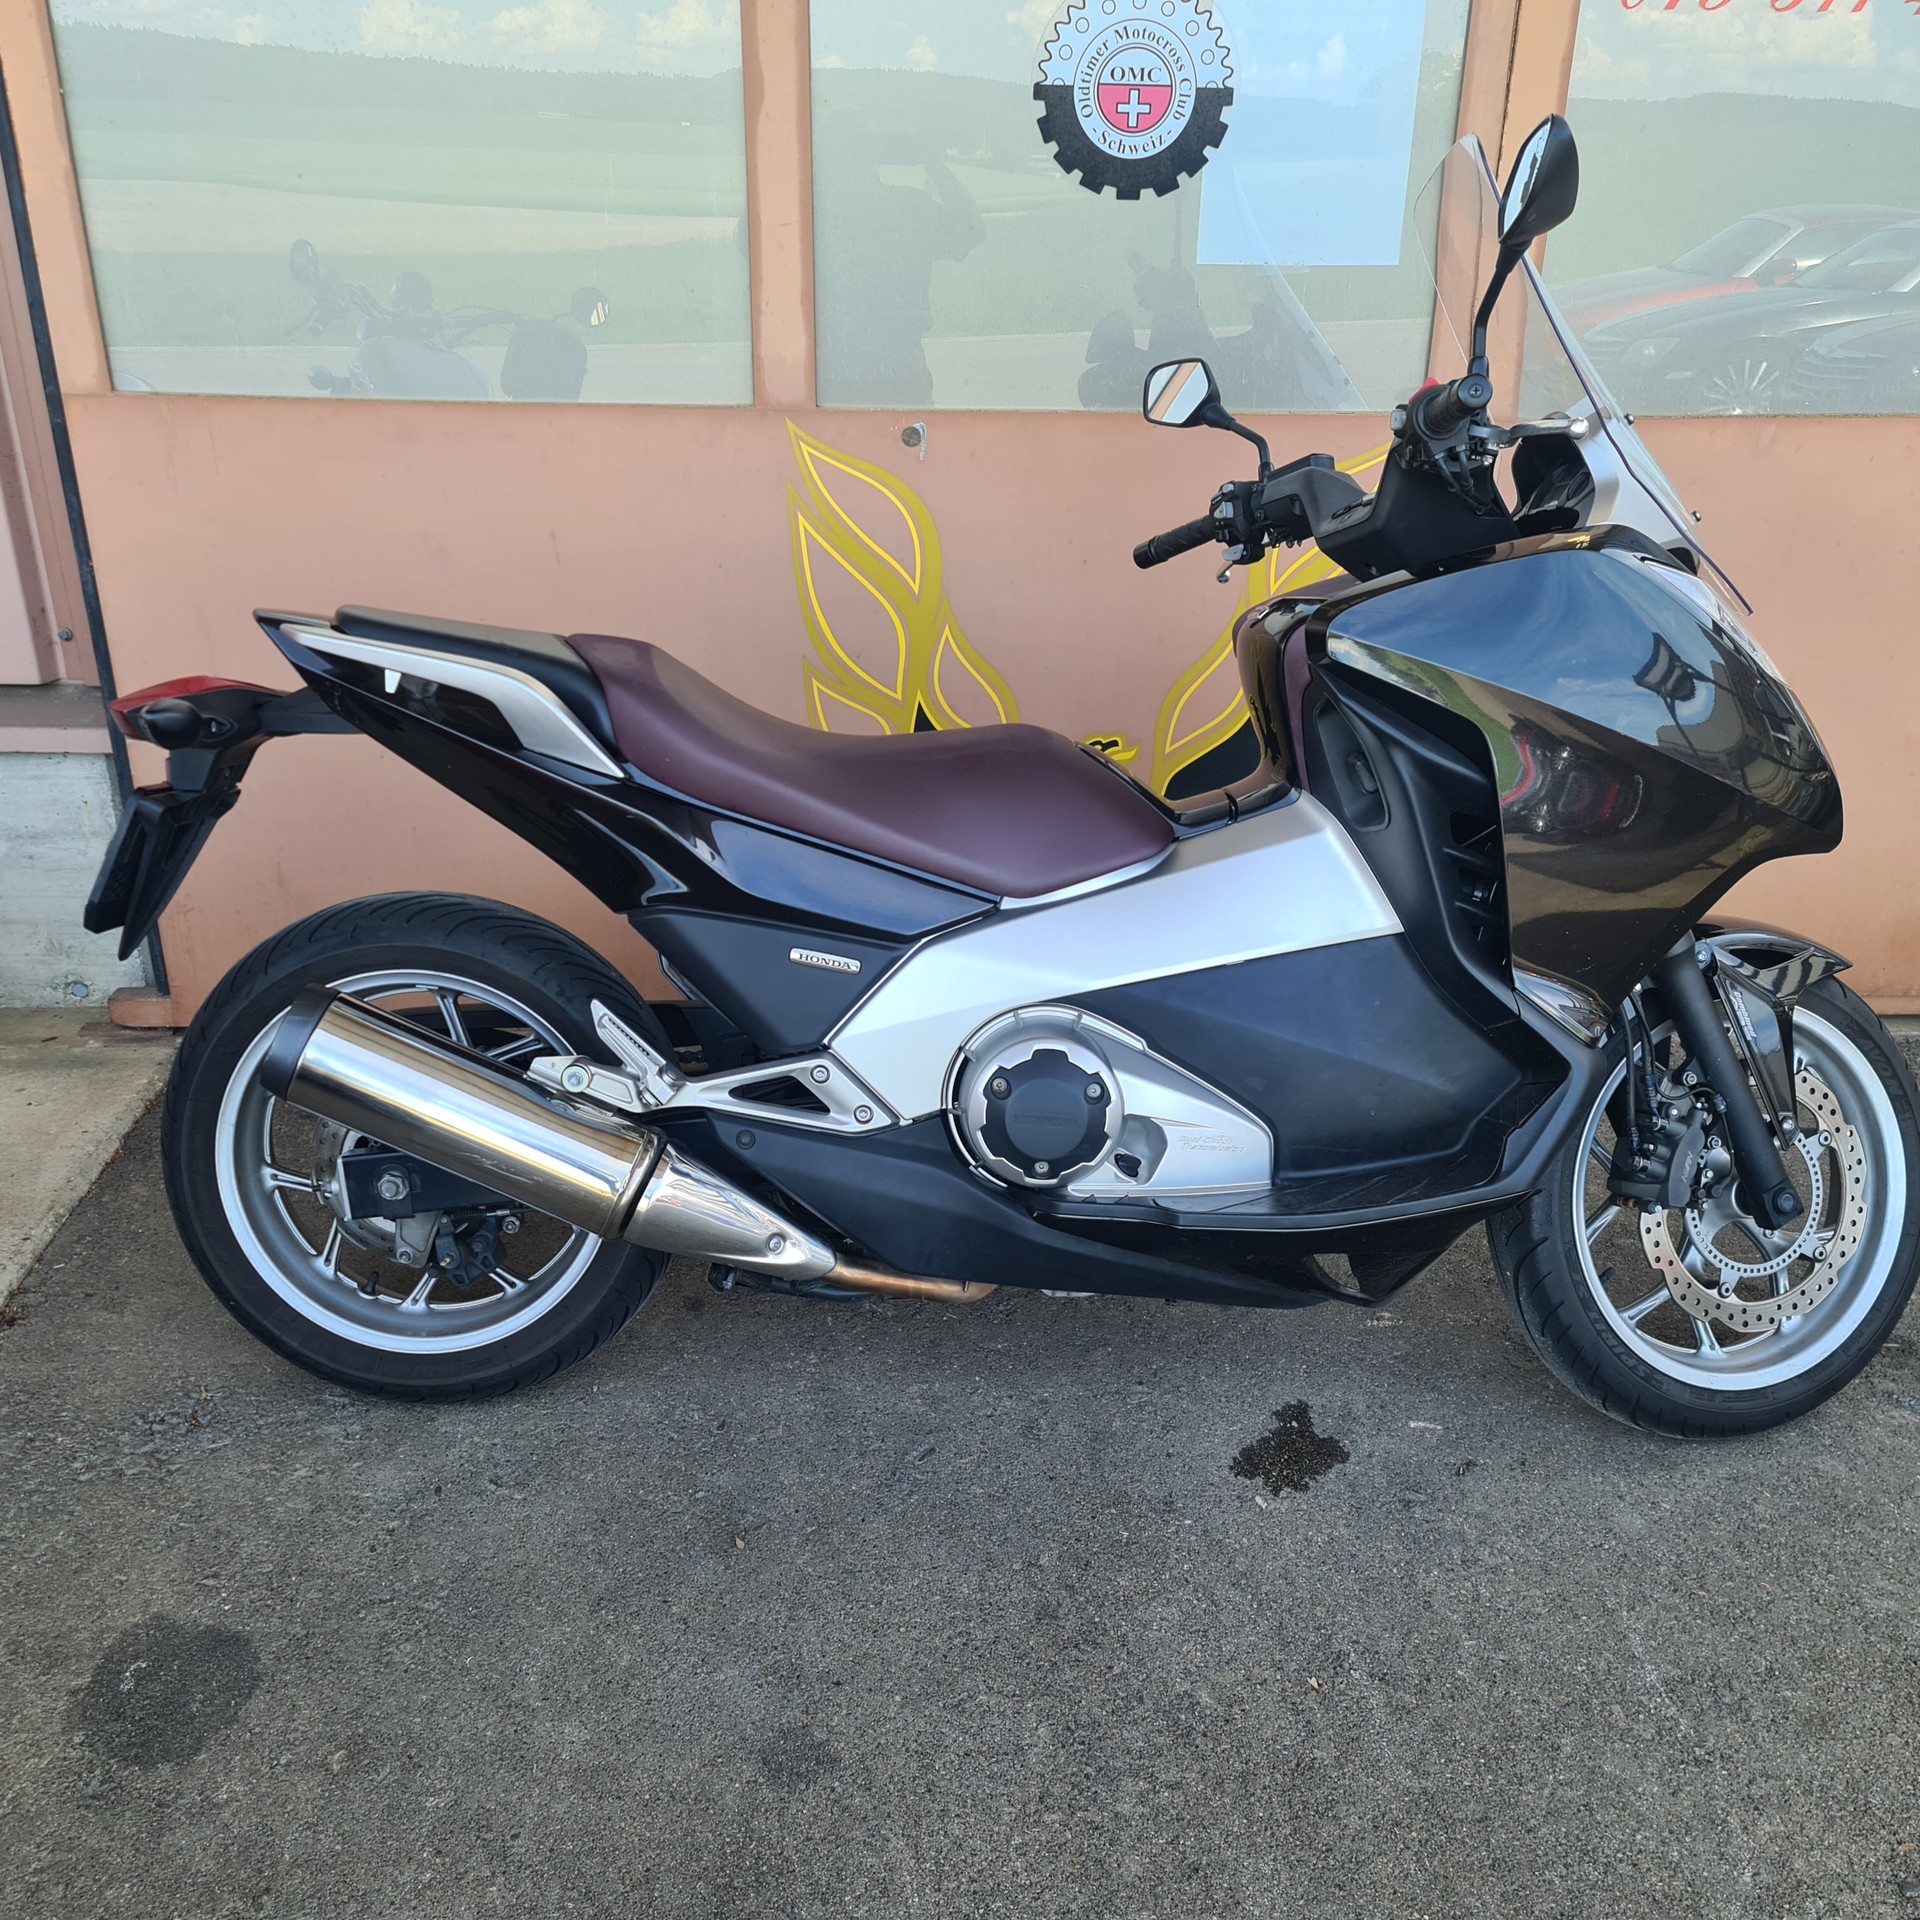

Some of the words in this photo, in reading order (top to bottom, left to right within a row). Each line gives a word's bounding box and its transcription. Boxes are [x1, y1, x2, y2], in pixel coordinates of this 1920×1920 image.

[1079, 39, 1109, 118] Oldtimer
[1114, 25, 1186, 72] Motocross
[1172, 78, 1192, 121] Club
[1110, 66, 1162, 83] OMC
[1098, 130, 1166, 155] Schweiz
[798, 953, 852, 970] HONDA
[1856, 1037, 1905, 1097] AVON
[1013, 1113, 1081, 1128] HONDA
